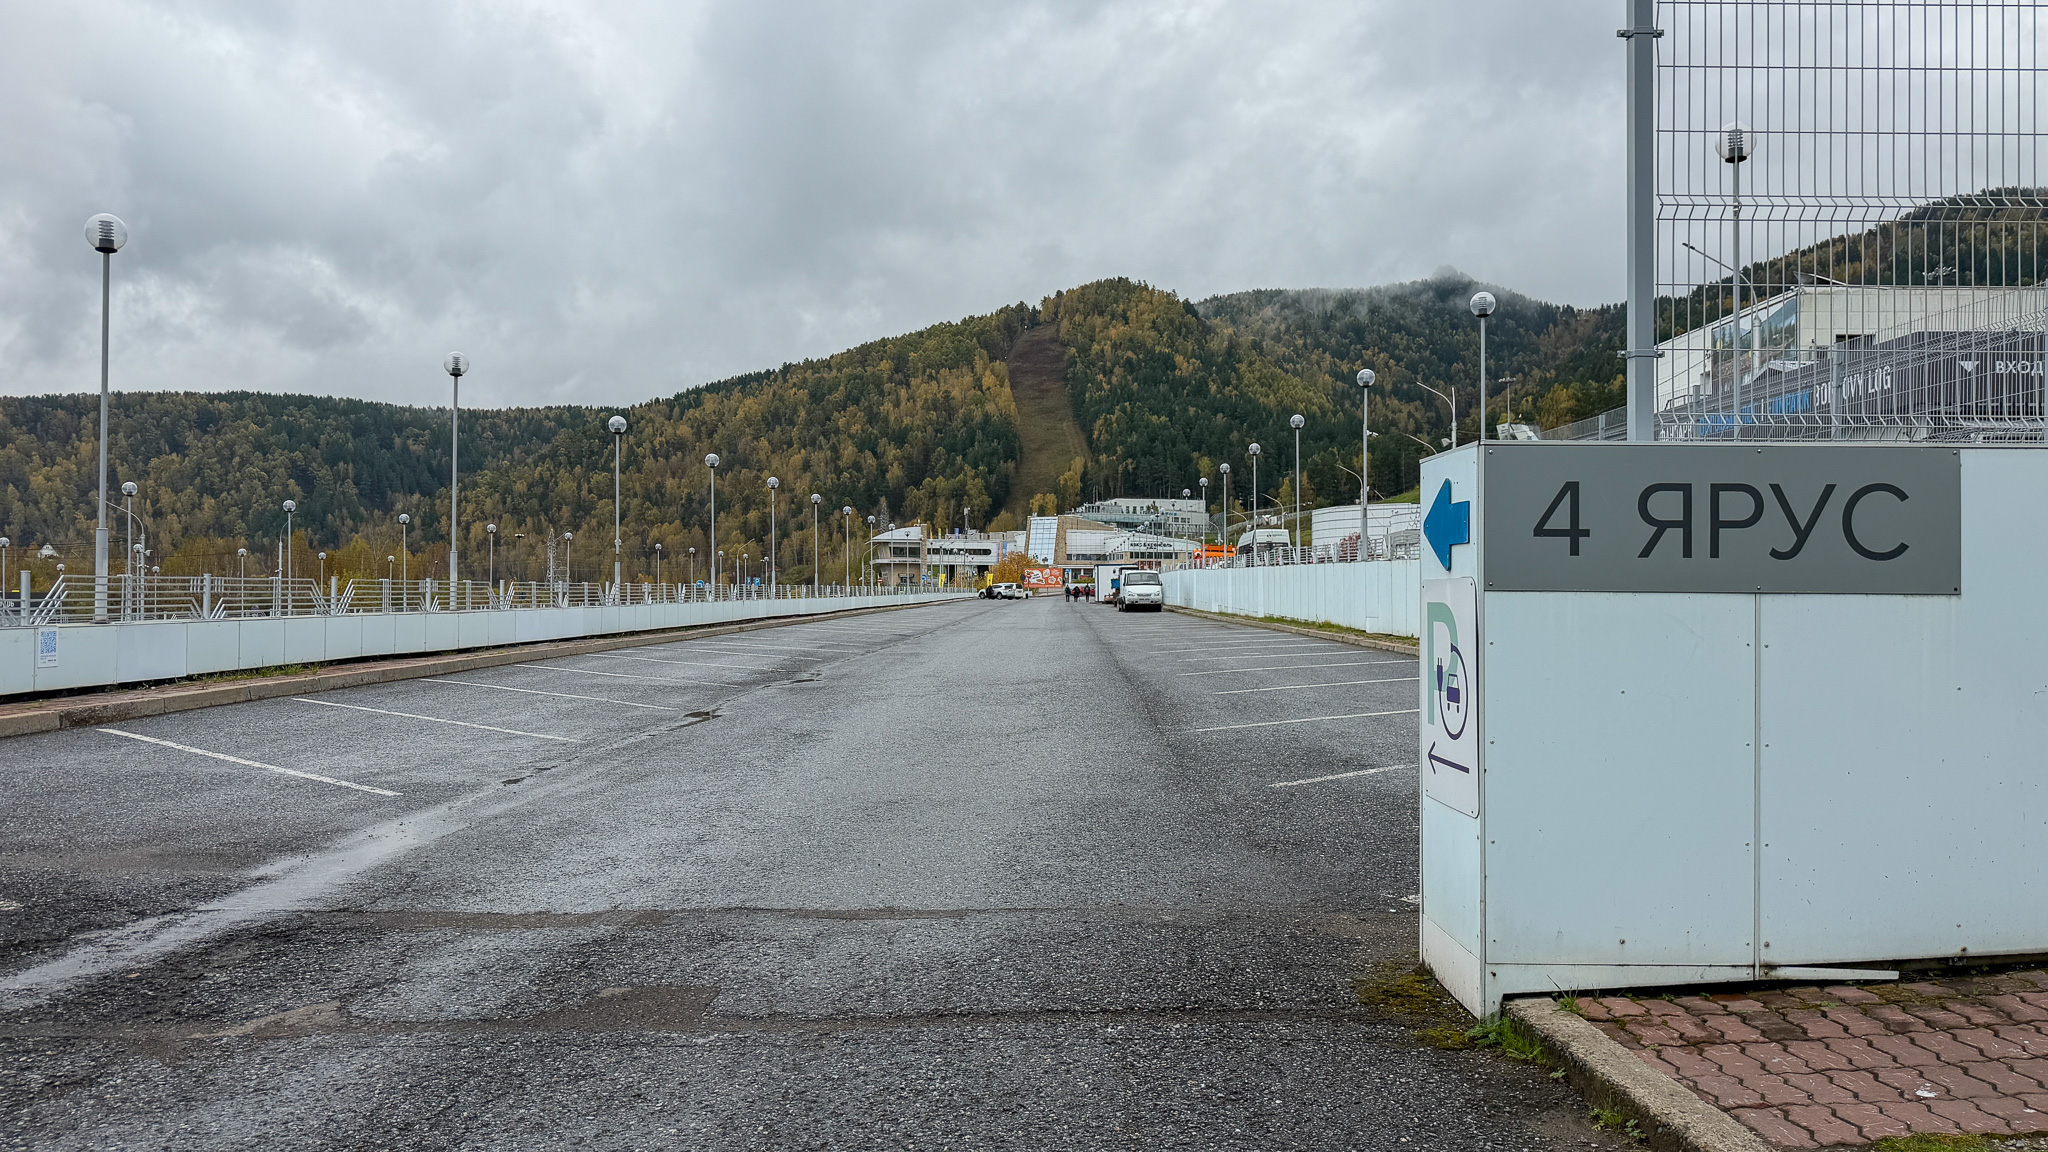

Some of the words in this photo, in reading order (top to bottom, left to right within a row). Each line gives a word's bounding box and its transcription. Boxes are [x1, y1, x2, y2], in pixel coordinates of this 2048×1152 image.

[1868, 365, 1891, 394] LOG
[1995, 360, 2044, 377] ВХОД
[1532, 481, 1591, 557] 4
[1637, 482, 1910, 562] ЯРУС
